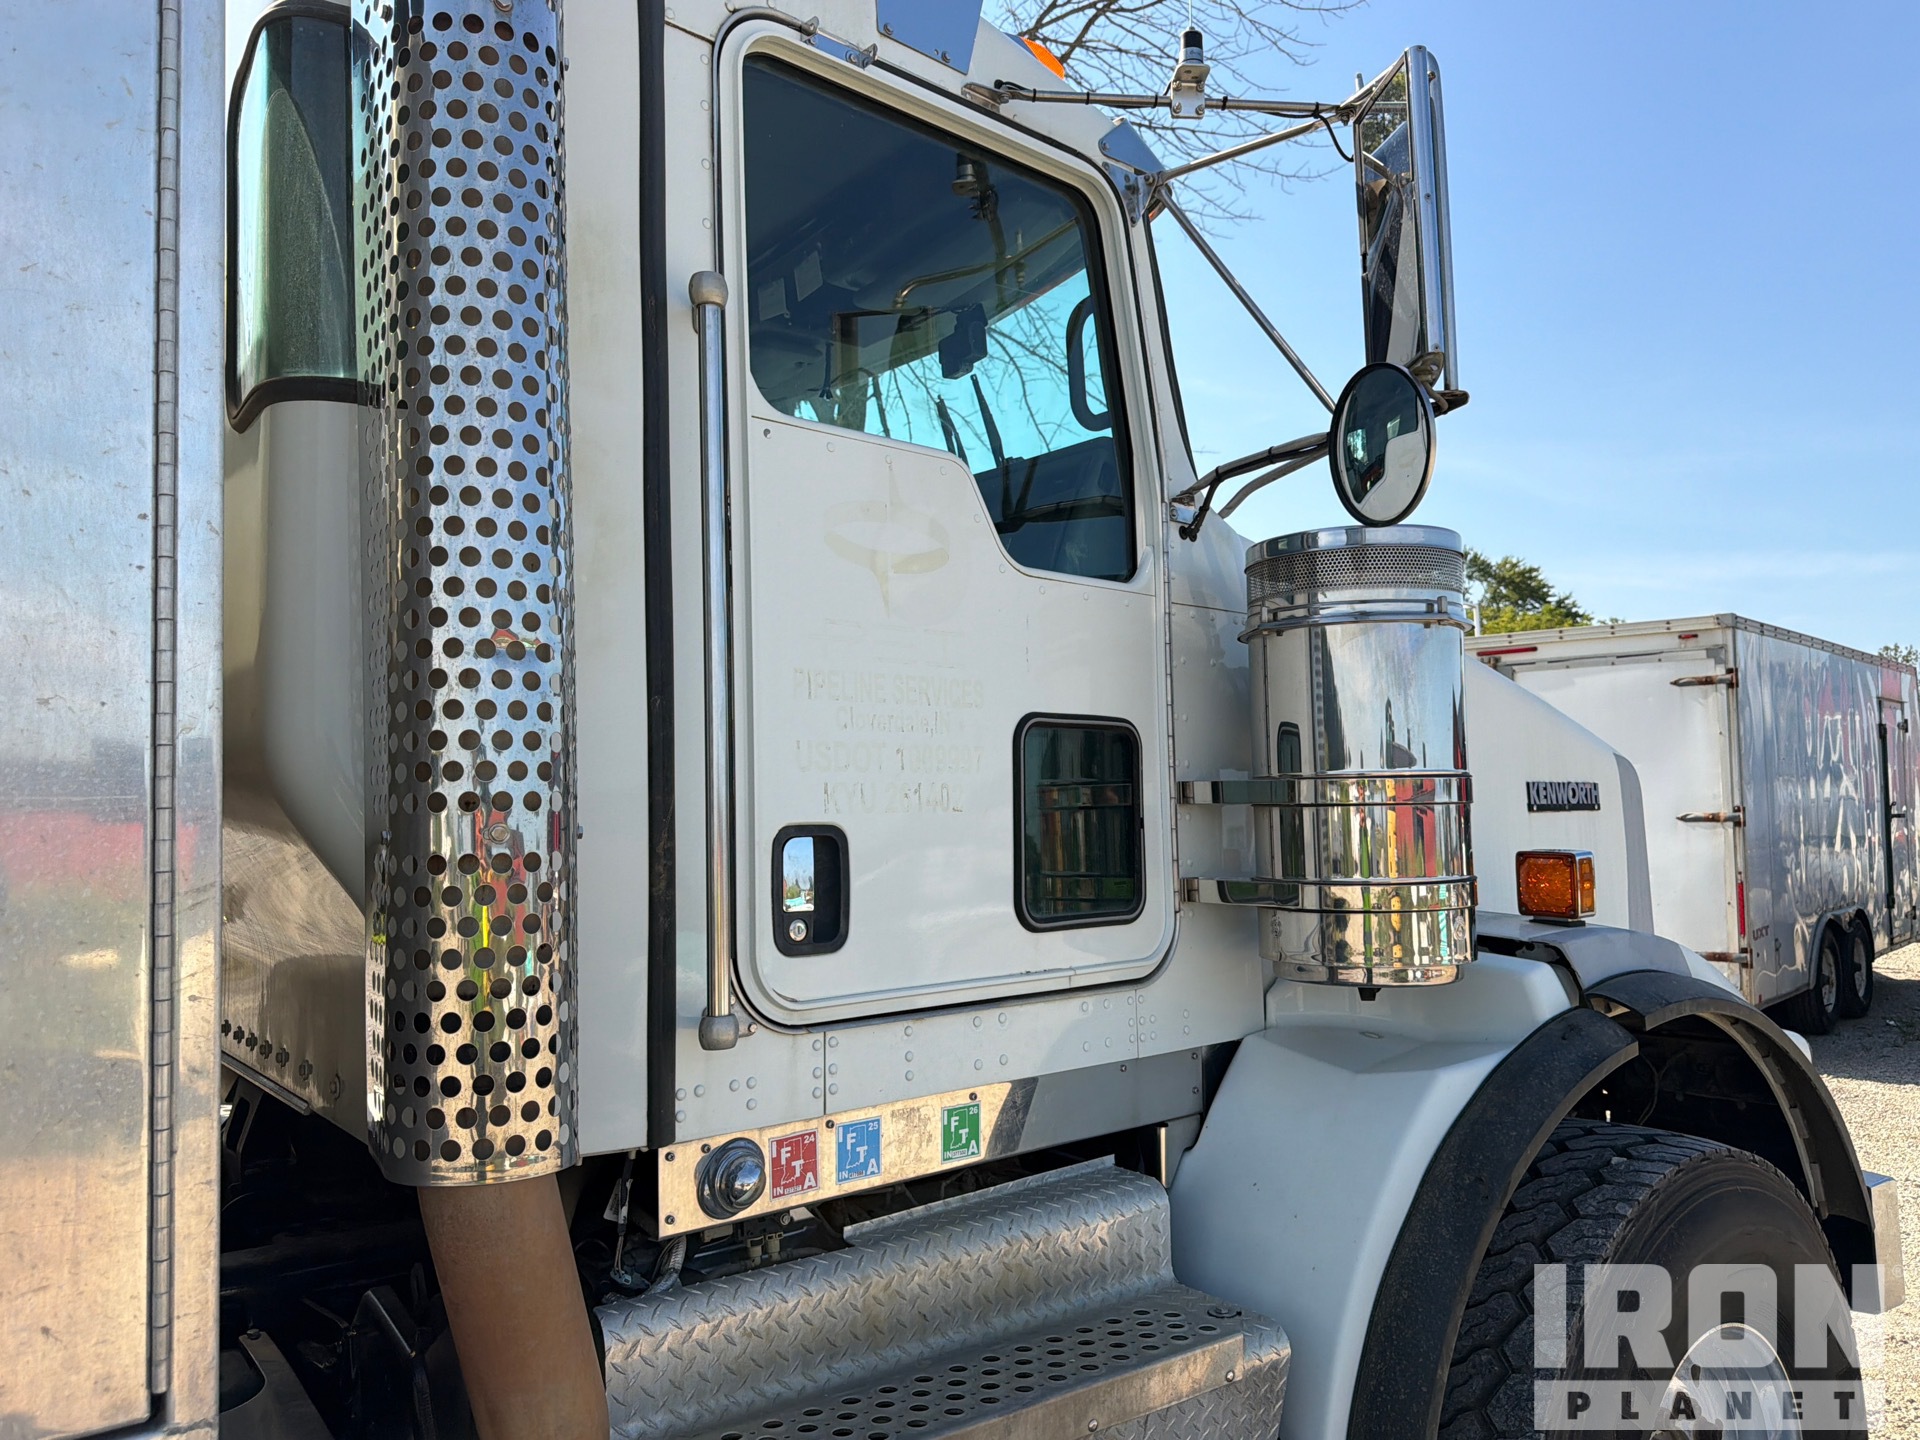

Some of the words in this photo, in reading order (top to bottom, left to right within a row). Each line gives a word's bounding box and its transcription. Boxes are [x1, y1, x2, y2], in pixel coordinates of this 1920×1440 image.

[1529, 781, 1600, 804] KENWORTH
[969, 1106, 979, 1115] 26
[868, 1121, 879, 1131] 25
[803, 1134, 815, 1144] 24
[838, 1170, 849, 1180] IN
[773, 1186, 784, 1197] IN
